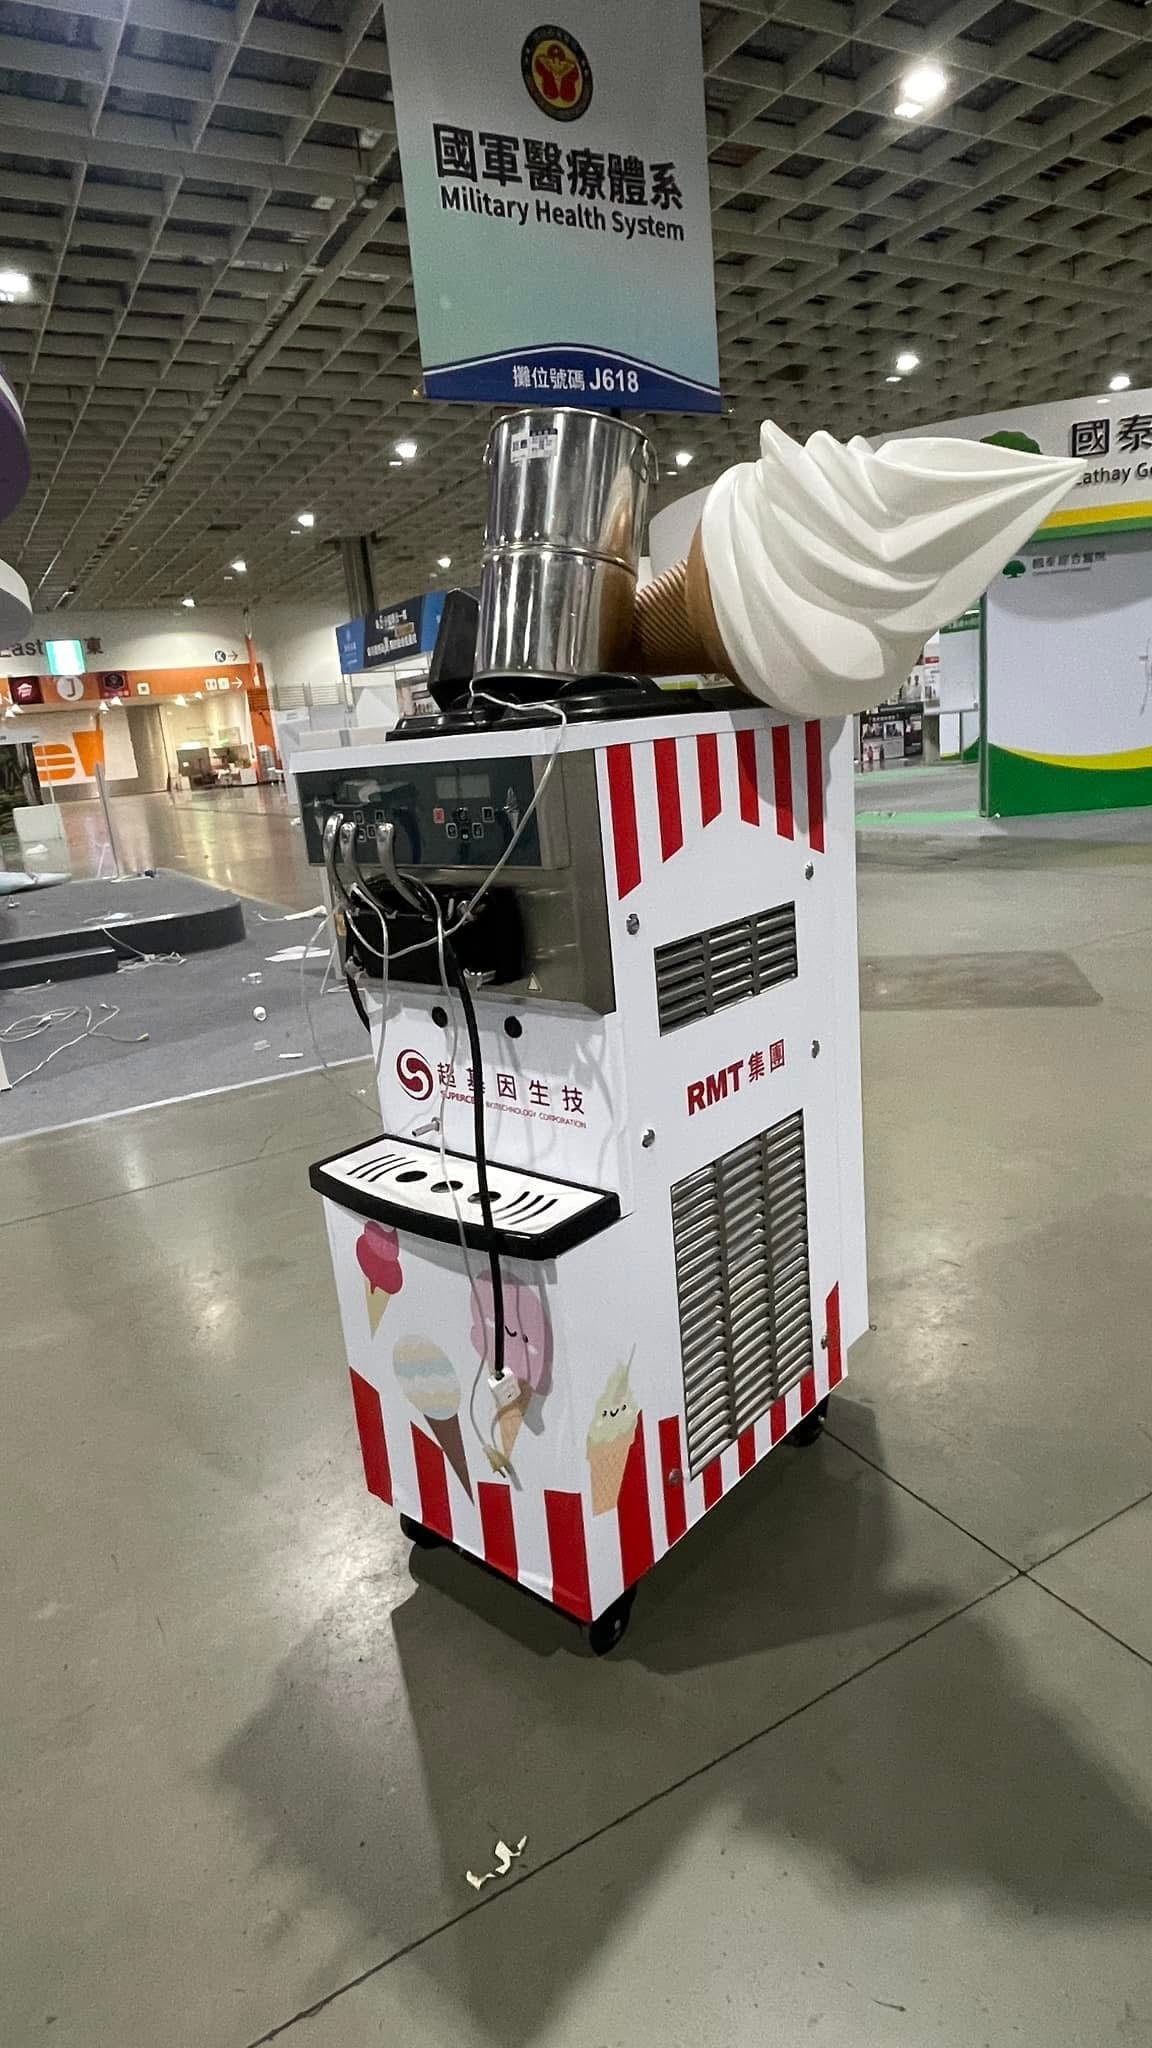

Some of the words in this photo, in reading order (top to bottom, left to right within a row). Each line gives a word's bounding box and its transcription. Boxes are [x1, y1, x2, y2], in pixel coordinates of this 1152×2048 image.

[433, 123, 683, 210] 國軍醫療體系
[440, 186, 529, 226] Military
[535, 199, 606, 231] Health
[612, 211, 685, 241] System
[513, 365, 585, 391] 攤位號碼
[589, 367, 639, 393] J618
[1072, 415, 1152, 457] 國泰
[1076, 467, 1131, 485] athay
